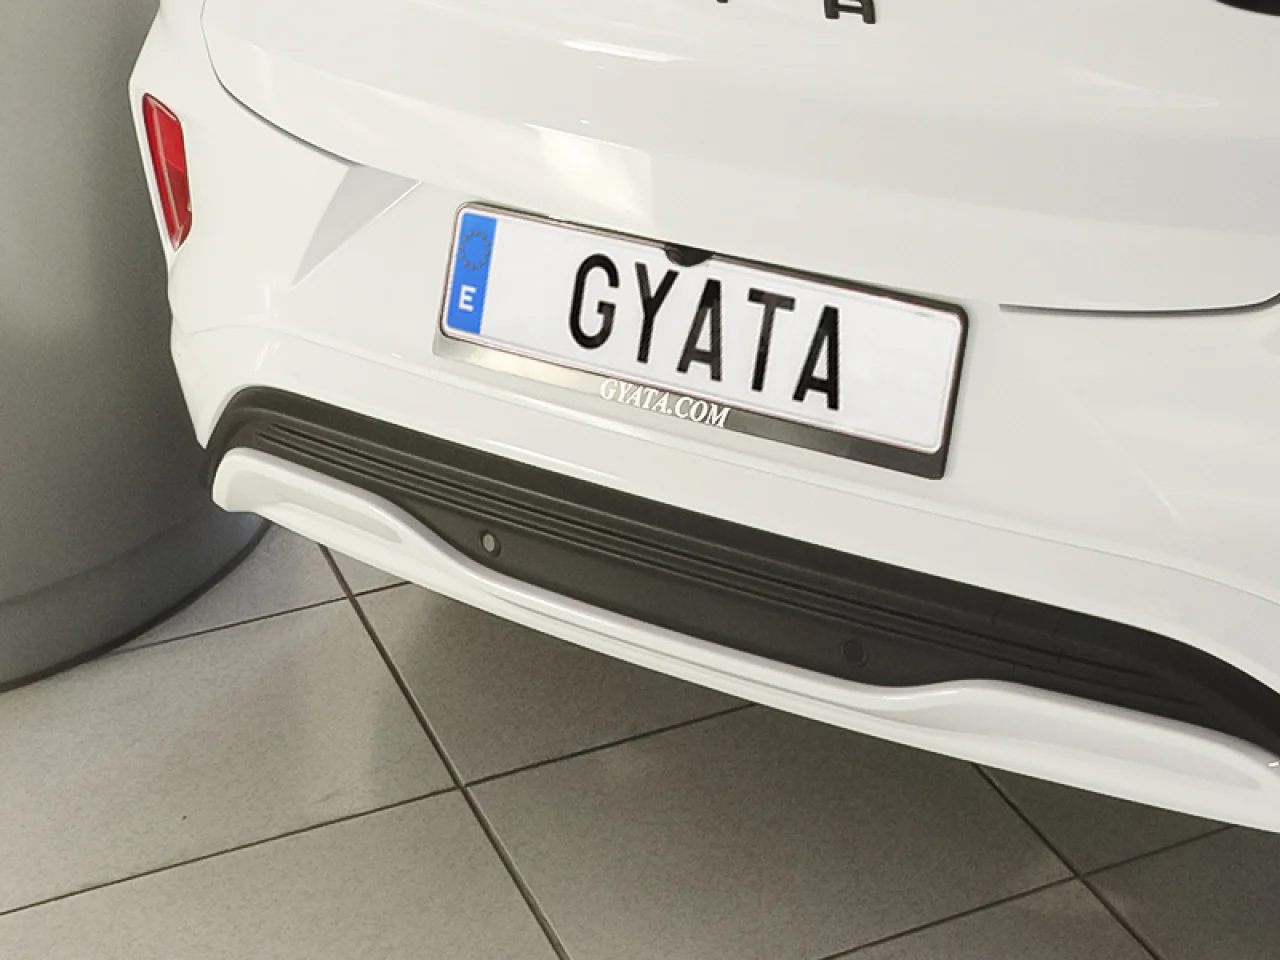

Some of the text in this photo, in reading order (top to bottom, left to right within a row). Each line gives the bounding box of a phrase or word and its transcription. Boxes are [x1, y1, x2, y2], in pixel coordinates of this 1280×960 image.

[458, 284, 477, 312] E
[568, 252, 840, 412] GYATA
[599, 378, 731, 428] GYATA.COM
